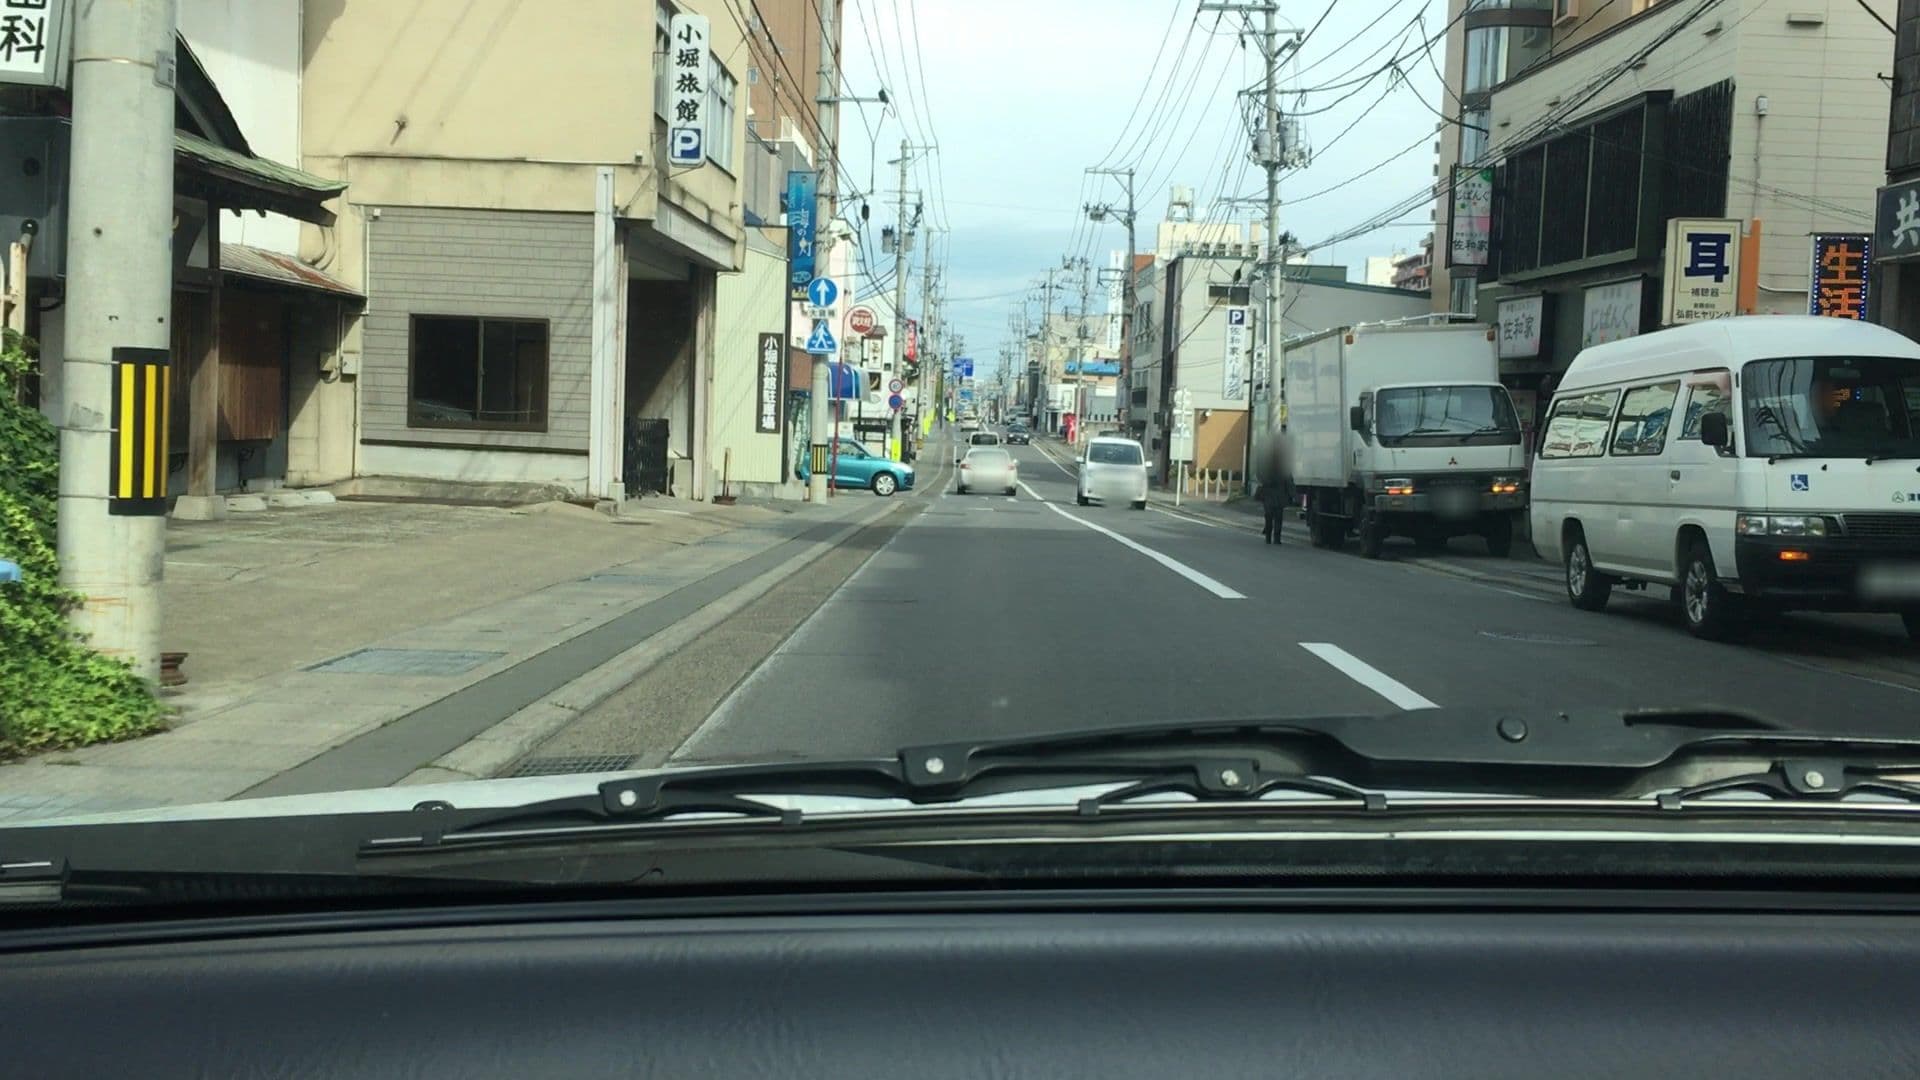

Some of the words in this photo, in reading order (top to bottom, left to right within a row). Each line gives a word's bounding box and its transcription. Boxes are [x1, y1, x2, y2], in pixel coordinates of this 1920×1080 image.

[0, 0, 46, 64] 科
[675, 23, 702, 121] 小堀旅館
[674, 130, 699, 157] P
[1453, 240, 1488, 252] 佐和家
[1684, 233, 1731, 283] 耳
[1691, 287, 1720, 297] 補聴器
[1231, 311, 1242, 323] P
[1676, 309, 1731, 319] 弘前ヒヤリング
[1504, 315, 1534, 340] 佐和家
